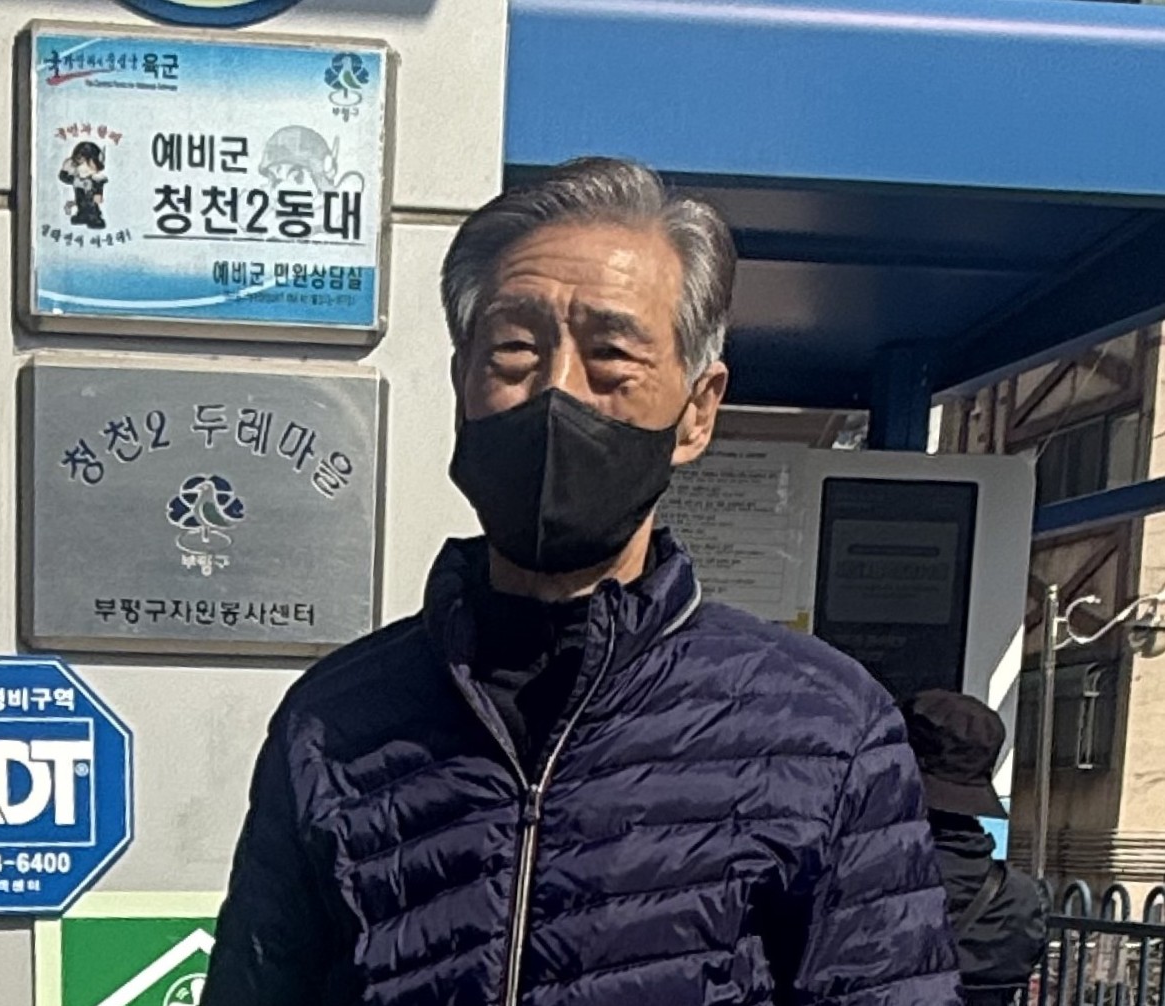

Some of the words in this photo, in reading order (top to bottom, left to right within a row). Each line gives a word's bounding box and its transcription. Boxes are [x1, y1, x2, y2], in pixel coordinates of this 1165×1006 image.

[143, 53, 179, 79] 육군
[152, 132, 249, 174] 예비군
[153, 184, 362, 241] 청천2동대
[212, 260, 265, 287] 예비군
[274, 262, 363, 292] 민원상담실
[61, 410, 171, 485] 청천2
[192, 403, 354, 499] 두레마을
[93, 598, 316, 627] 부평구자원봉사센터
